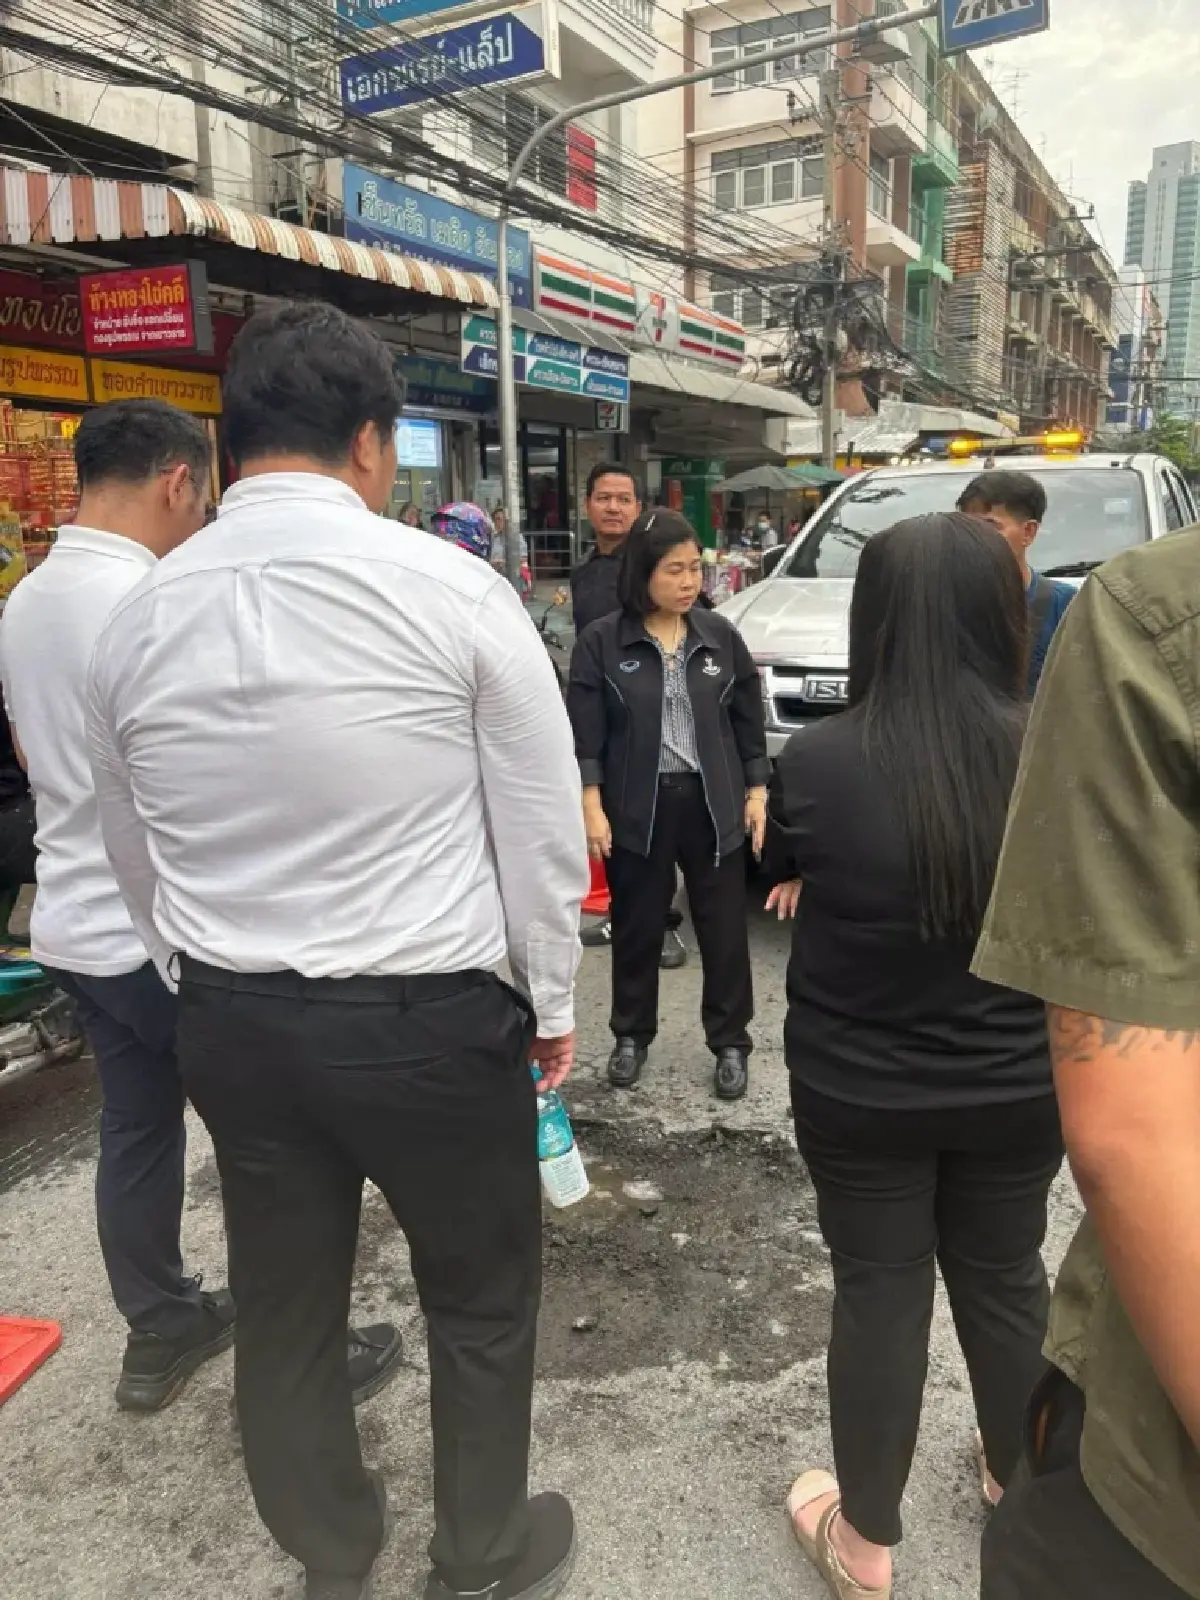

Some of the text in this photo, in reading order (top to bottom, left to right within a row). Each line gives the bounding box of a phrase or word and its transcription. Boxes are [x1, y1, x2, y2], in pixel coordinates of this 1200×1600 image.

[89, 275, 185, 312] ห้างทองโชคดี
